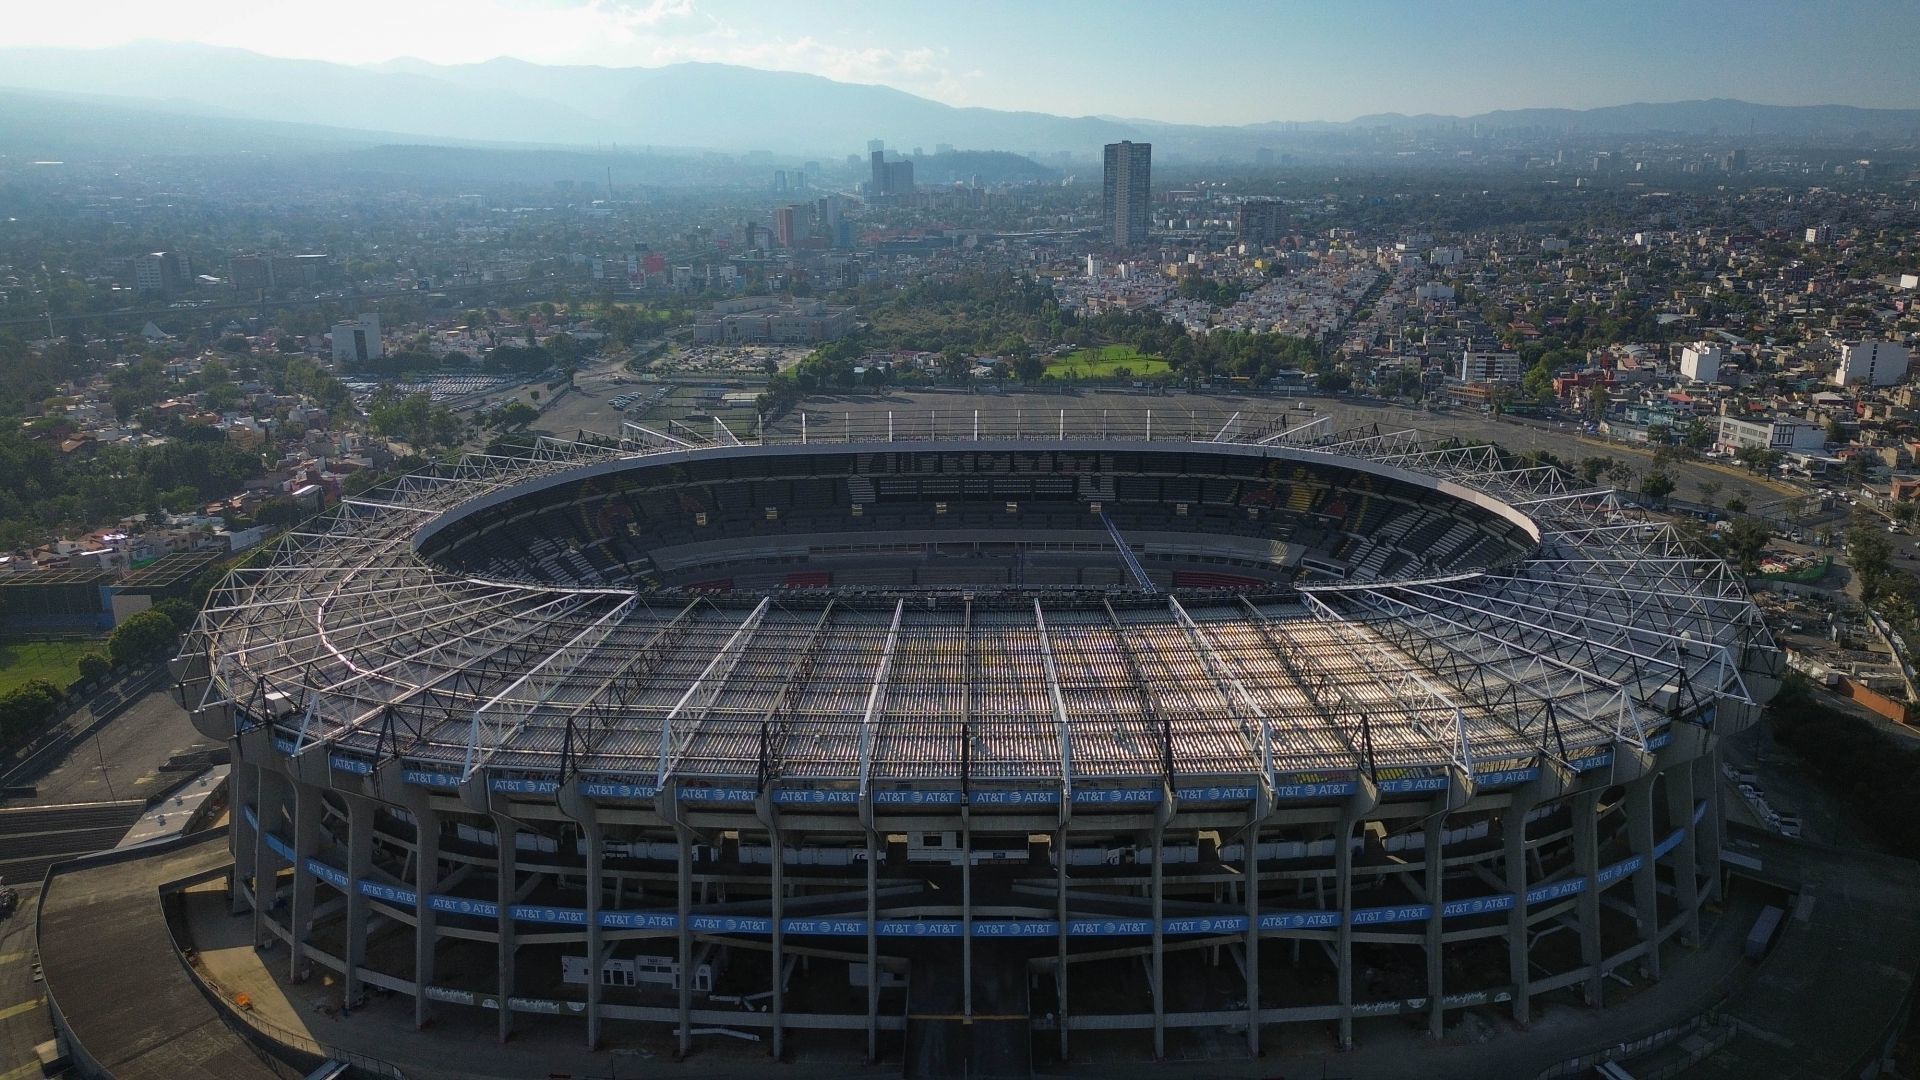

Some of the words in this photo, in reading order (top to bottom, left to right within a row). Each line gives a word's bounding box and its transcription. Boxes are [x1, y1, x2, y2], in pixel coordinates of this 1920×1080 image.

[1650, 735, 1668, 748] AT&T
[334, 759, 354, 771] AT&T
[1584, 755, 1608, 769] AT&T
[408, 773, 432, 785] AT&T
[1504, 770, 1529, 781] AT&T
[494, 780, 520, 791] AT&T
[538, 782, 557, 792] AT&
[587, 784, 615, 795] AT&T
[1319, 783, 1348, 794] AT&T
[1378, 781, 1397, 791] T&T
[1415, 778, 1443, 789] AT&T
[681, 788, 709, 799] AT&T
[727, 789, 756, 800] AT&T
[780, 791, 808, 801] AT&T
[827, 792, 855, 802] AT&T
[878, 792, 906, 802] AT&T
[926, 792, 954, 802] AT&T
[976, 792, 1005, 802] AT&T
[1024, 792, 1053, 802] AT&T
[1077, 791, 1105, 801] AT&T
[1124, 791, 1153, 801] AT&T
[1176, 790, 1203, 800] AT&T
[1222, 788, 1251, 798] AT&T
[308, 862, 324, 877] AT&T
[1622, 858, 1641, 873] AT&T
[362, 883, 382, 897] AT&T
[396, 891, 417, 903] AT&T
[1526, 888, 1548, 903] AT&T
[1560, 880, 1583, 894] AT&T
[432, 898, 457, 909] AT&T
[473, 903, 497, 914] AT&T
[1444, 903, 1469, 915] AT&T
[1484, 897, 1510, 909] AT&T
[515, 908, 541, 919] AT&T
[558, 911, 583, 921] AT&T
[604, 914, 630, 925] AT&T
[648, 916, 674, 926] AT&T
[1262, 917, 1289, 927] AT&T
[1307, 914, 1335, 925] AT&T
[1354, 911, 1381, 922] AT&T
[1399, 907, 1426, 918] AT&T
[694, 918, 721, 928] AT&T
[740, 920, 767, 930] AT&T
[788, 921, 815, 931] AT&T
[834, 922, 861, 932] AT&T
[882, 923, 910, 933] AT&T
[929, 924, 957, 934] AT&T
[977, 924, 1005, 934] AT&T
[1023, 924, 1051, 933] AT&T
[1072, 923, 1100, 933] AT&T
[1118, 922, 1147, 932] AT&T
[1168, 921, 1196, 932] AT&T
[1214, 919, 1242, 929] AT&T
